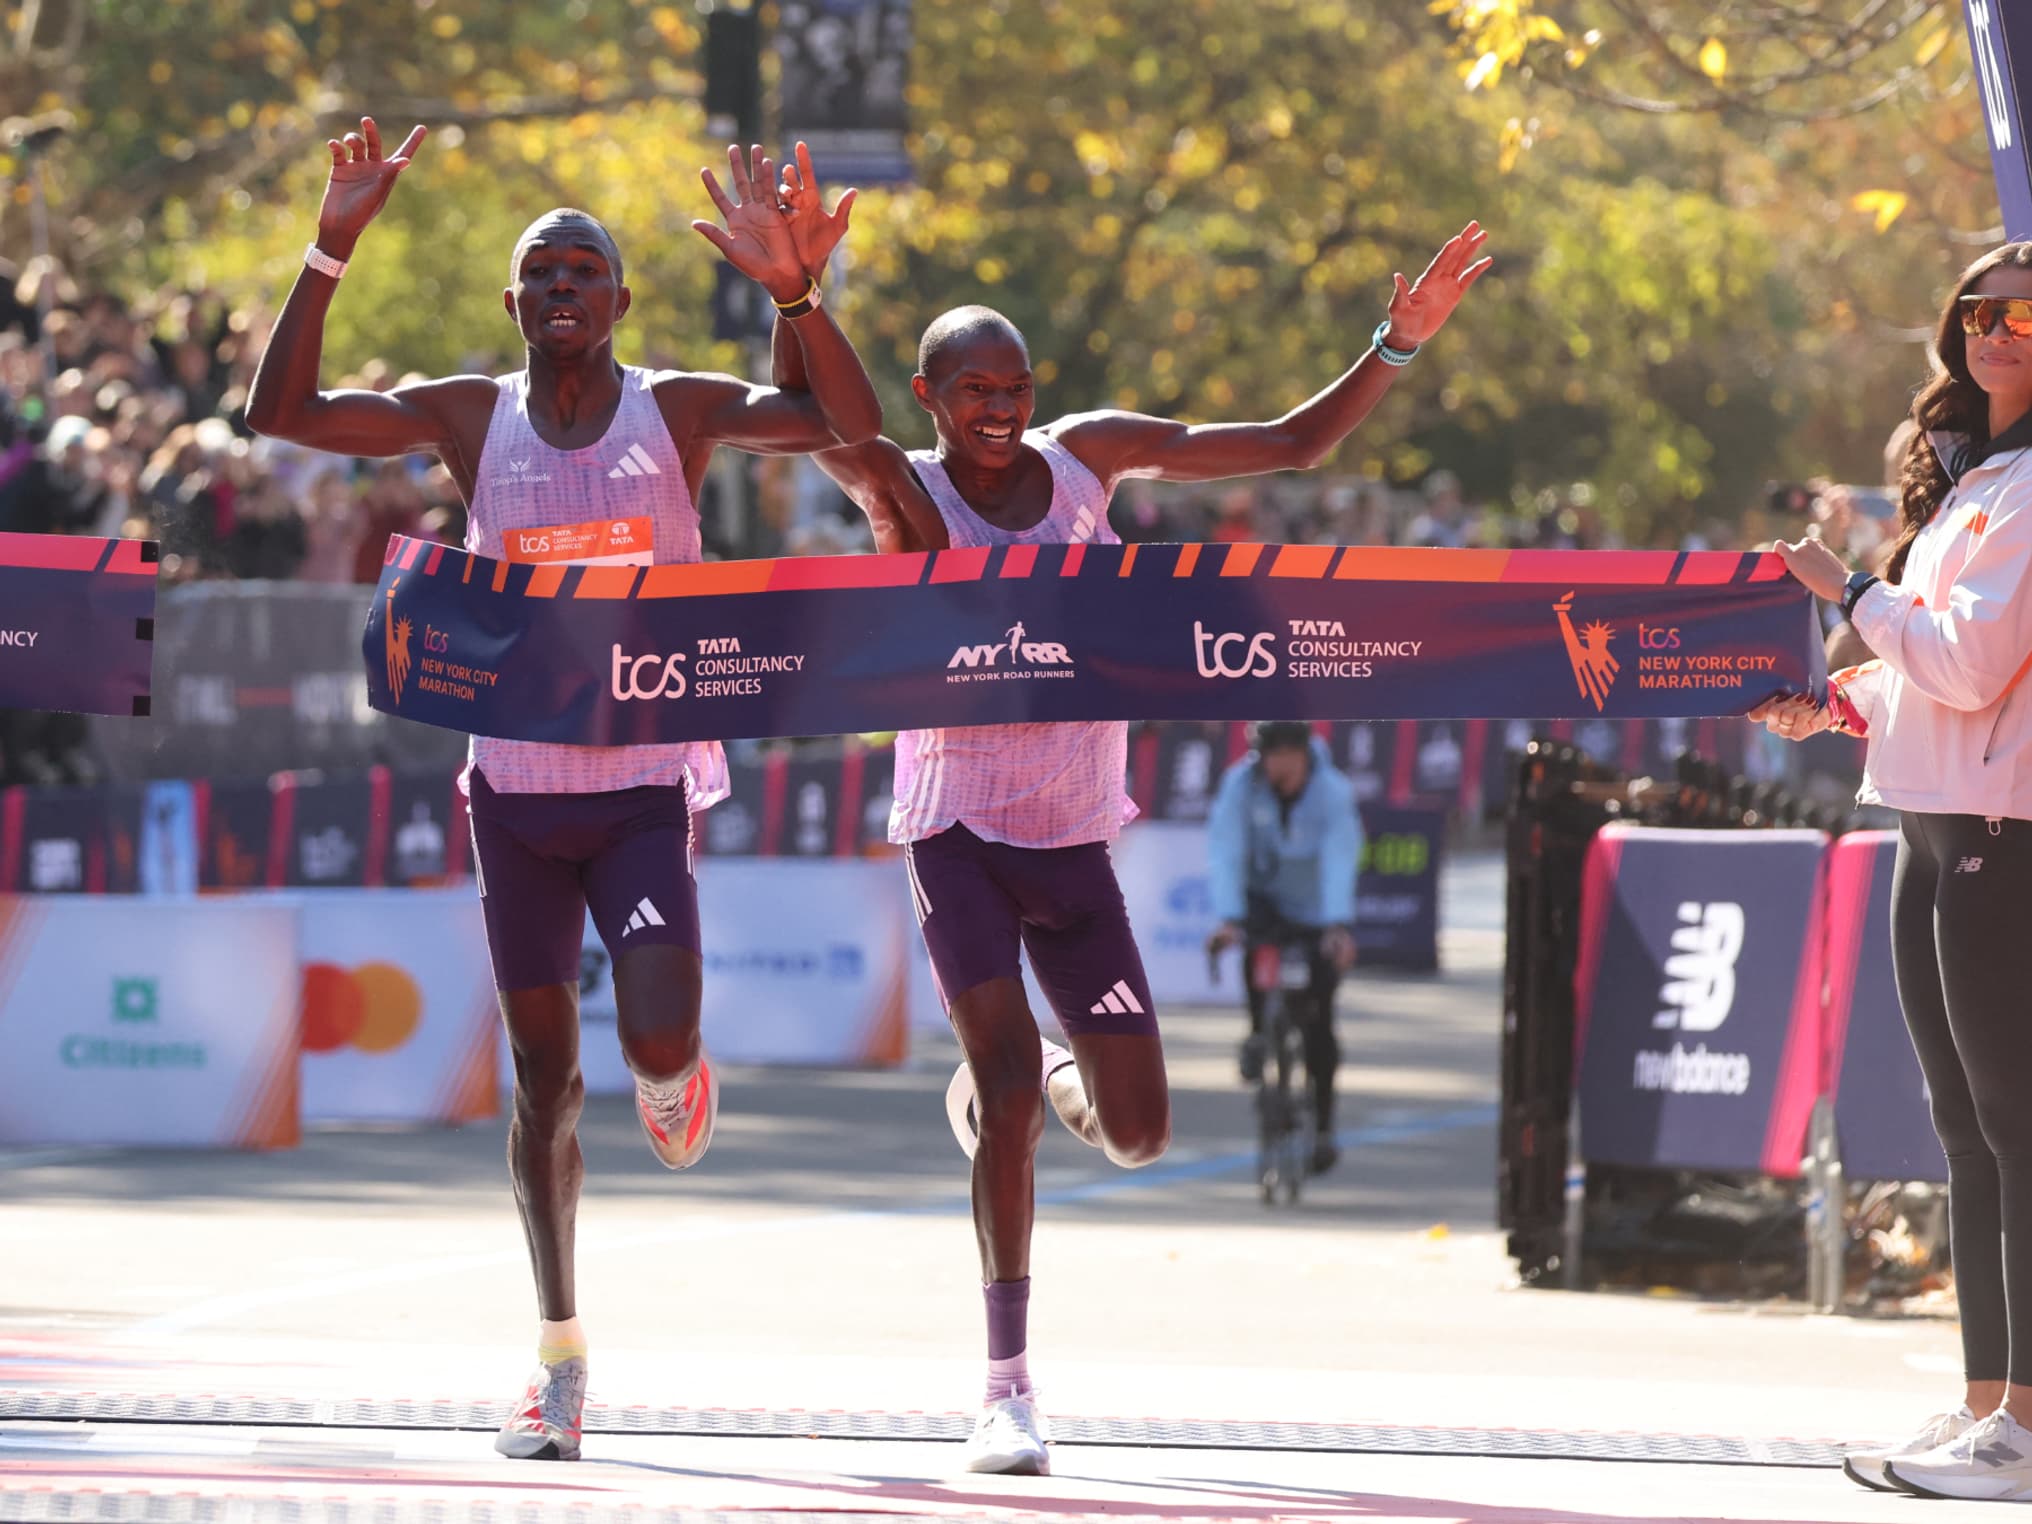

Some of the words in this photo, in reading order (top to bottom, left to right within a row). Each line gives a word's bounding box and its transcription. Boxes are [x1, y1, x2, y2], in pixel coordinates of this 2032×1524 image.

[552, 529, 572, 537] TATA
[609, 536, 634, 545] TATA
[519, 533, 550, 553] tcs
[1288, 620, 1346, 637] TATA
[1638, 622, 1681, 649] tcs
[424, 623, 449, 653] tcs
[697, 637, 741, 655] TATA
[1194, 620, 1277, 678] tcs
[1288, 641, 1422, 657] CONSULTANCY
[421, 657, 445, 675] NEW
[446, 662, 473, 681] YORK
[473, 670, 499, 687] CITY
[612, 643, 687, 701] tcs
[695, 655, 805, 676] CONSULTANCY
[1288, 661, 1372, 678] SERVICES
[1638, 656, 1681, 670] NEW
[1685, 656, 1733, 670] YORK
[1736, 656, 1776, 670] CITY
[946, 674, 971, 683] NEW
[973, 672, 1000, 681] YORK
[1003, 671, 1031, 680] ROAD
[1034, 670, 1075, 679] RUNNERS
[1638, 674, 1742, 689] MARATHON
[418, 675, 476, 702] MARATHON
[695, 678, 762, 697] SERVICES
